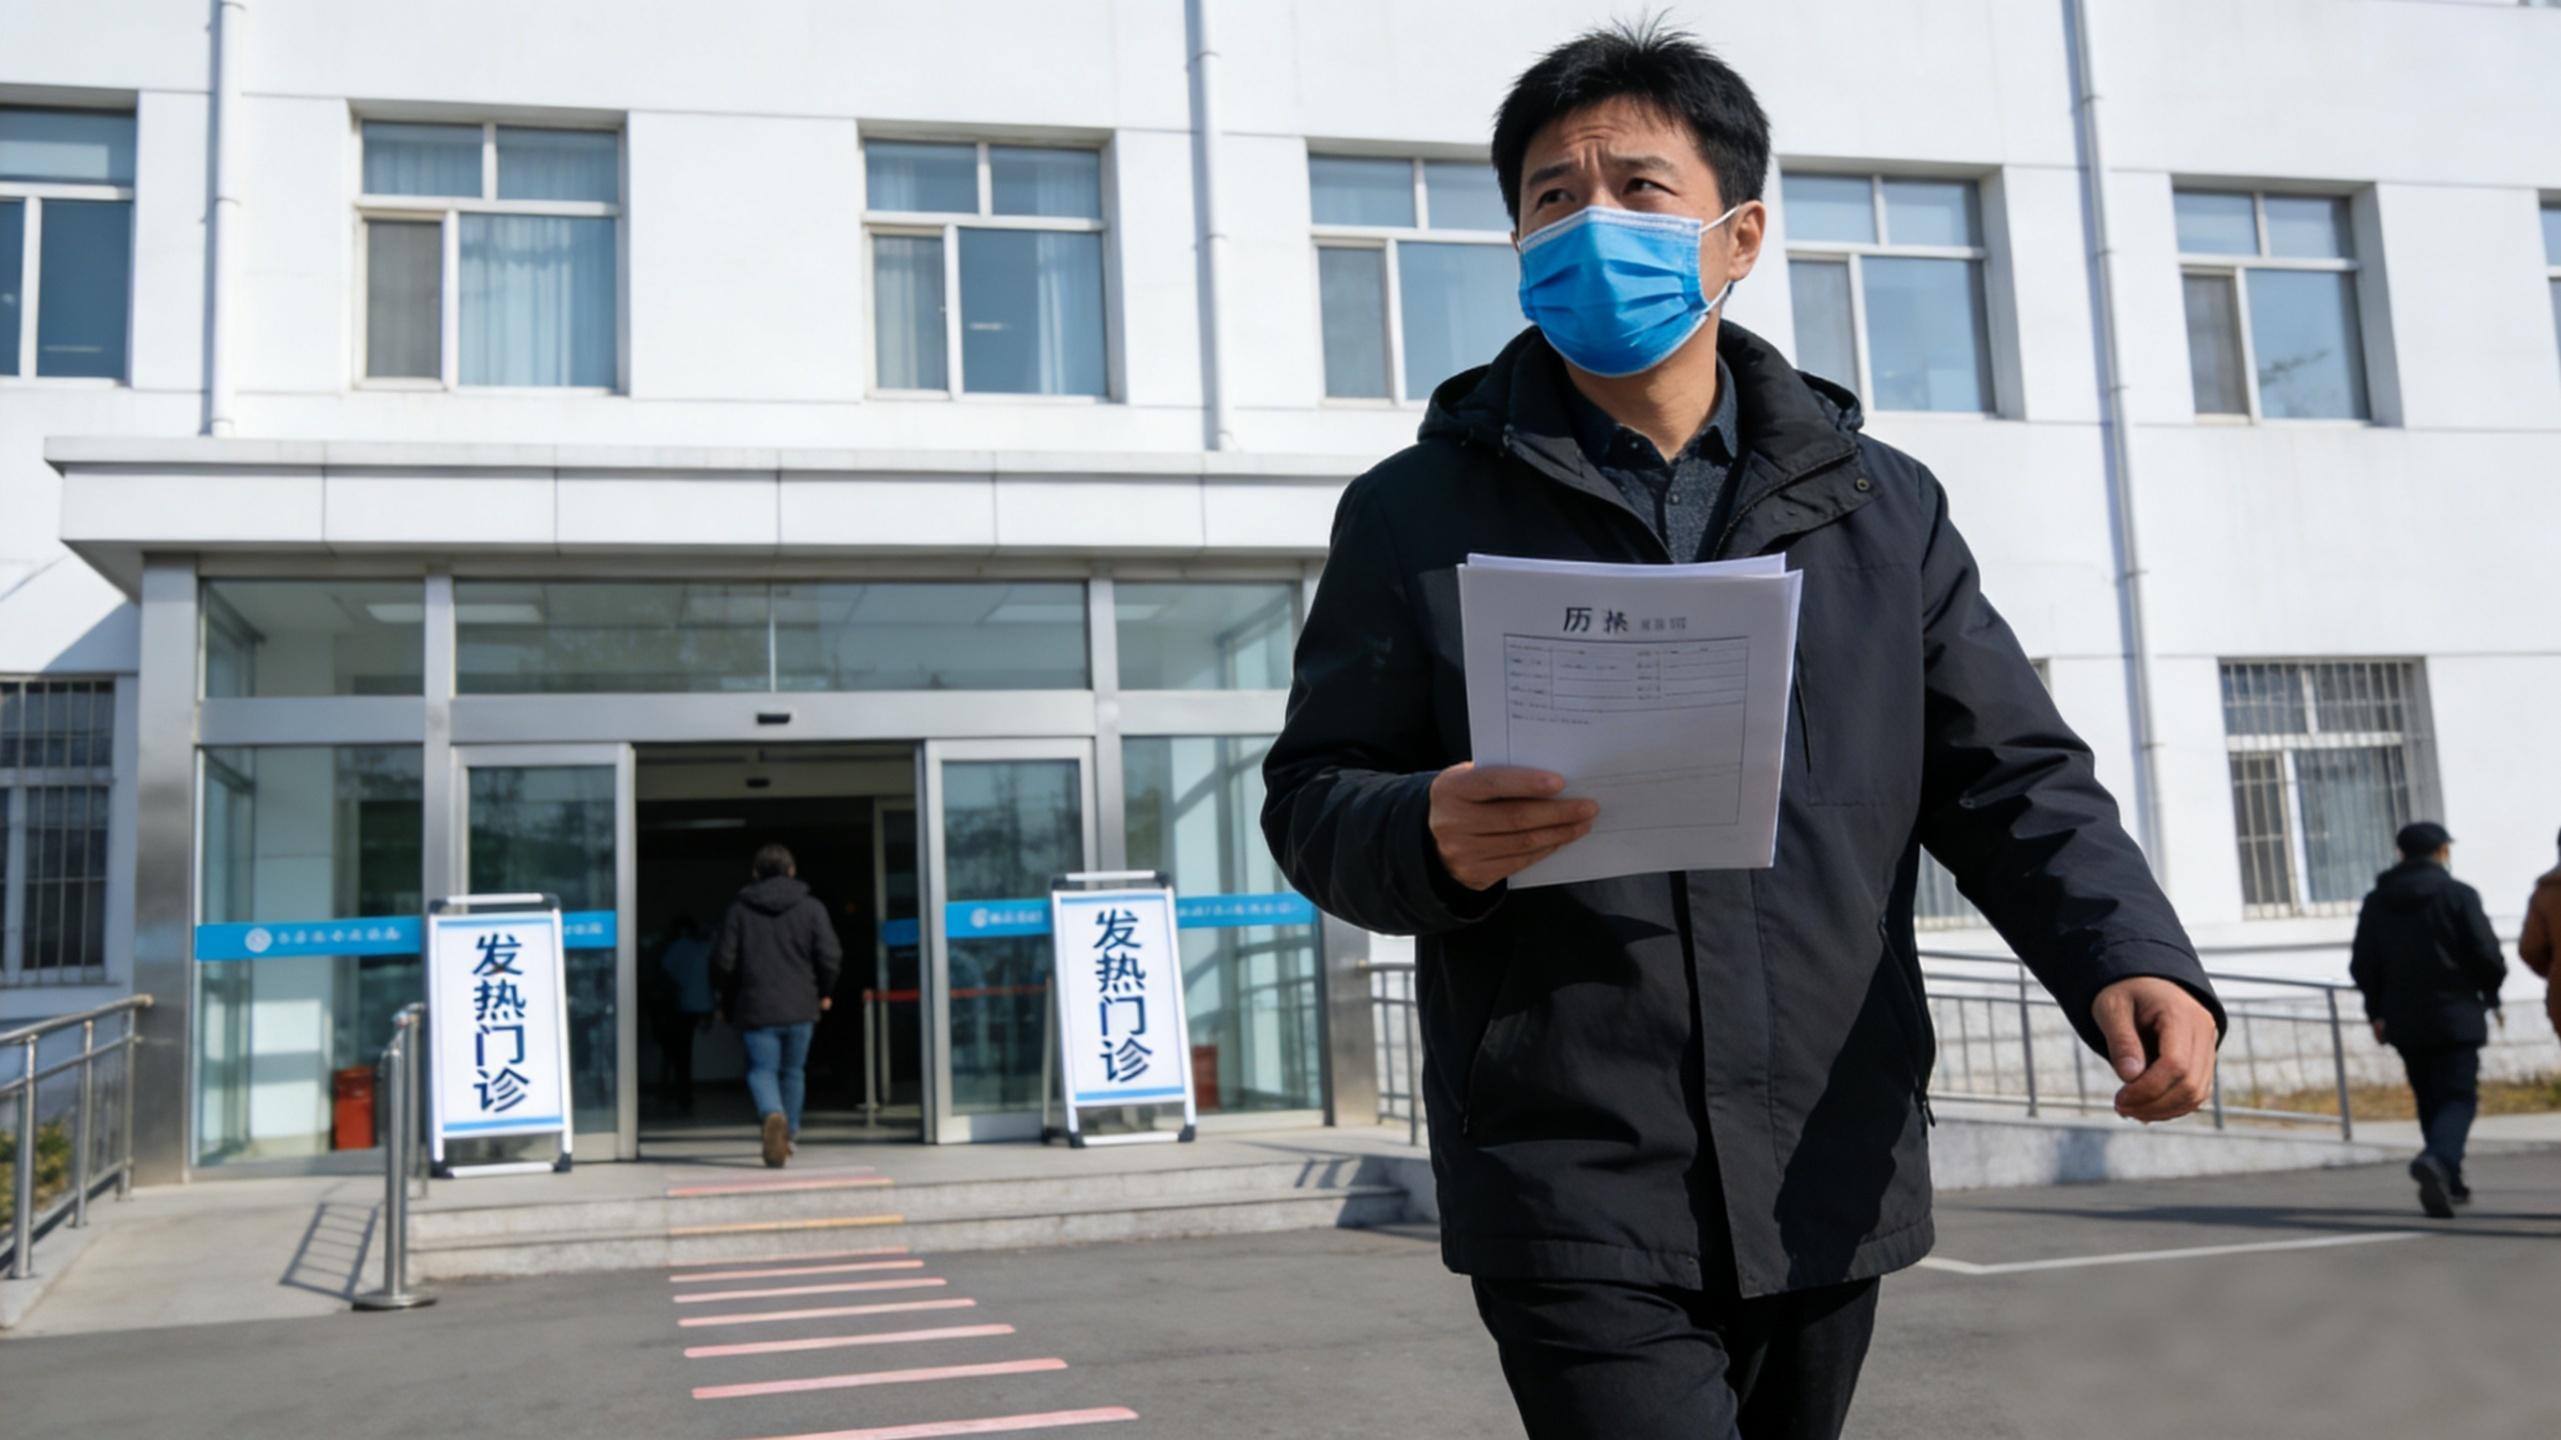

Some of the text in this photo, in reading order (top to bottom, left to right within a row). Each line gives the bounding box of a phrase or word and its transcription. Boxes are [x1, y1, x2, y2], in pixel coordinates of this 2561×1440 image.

[472, 933, 530, 1113] 发热门诊
[1093, 909, 1152, 1082] 发热门诊
